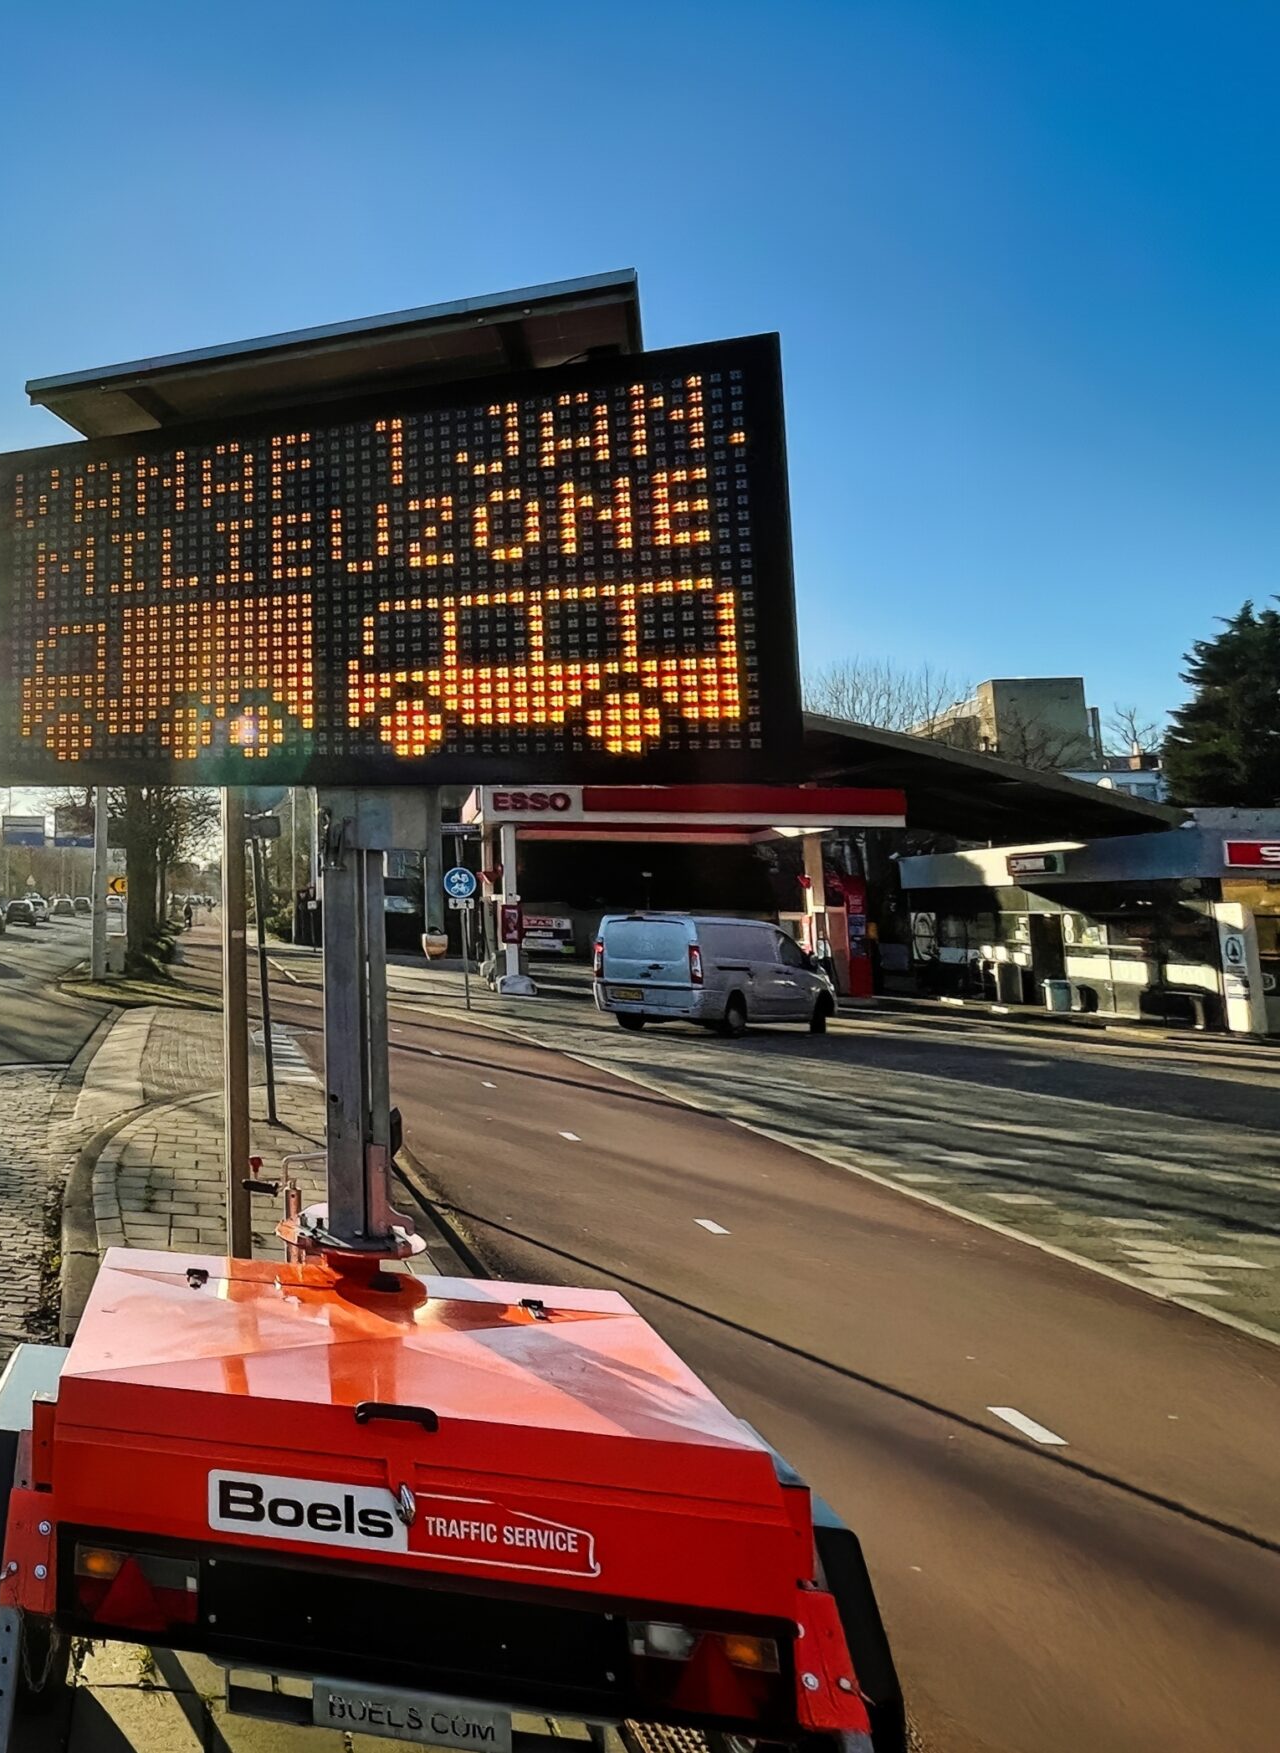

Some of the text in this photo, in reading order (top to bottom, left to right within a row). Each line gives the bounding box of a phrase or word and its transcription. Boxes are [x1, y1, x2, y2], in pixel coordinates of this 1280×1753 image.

[16, 374, 747, 528] VANAF 1 JAN.
[37, 467, 711, 599] MILIEUZONE
[493, 792, 572, 812] ESSO
[218, 1479, 579, 1554] Boels TRAFFIC SERVICE
